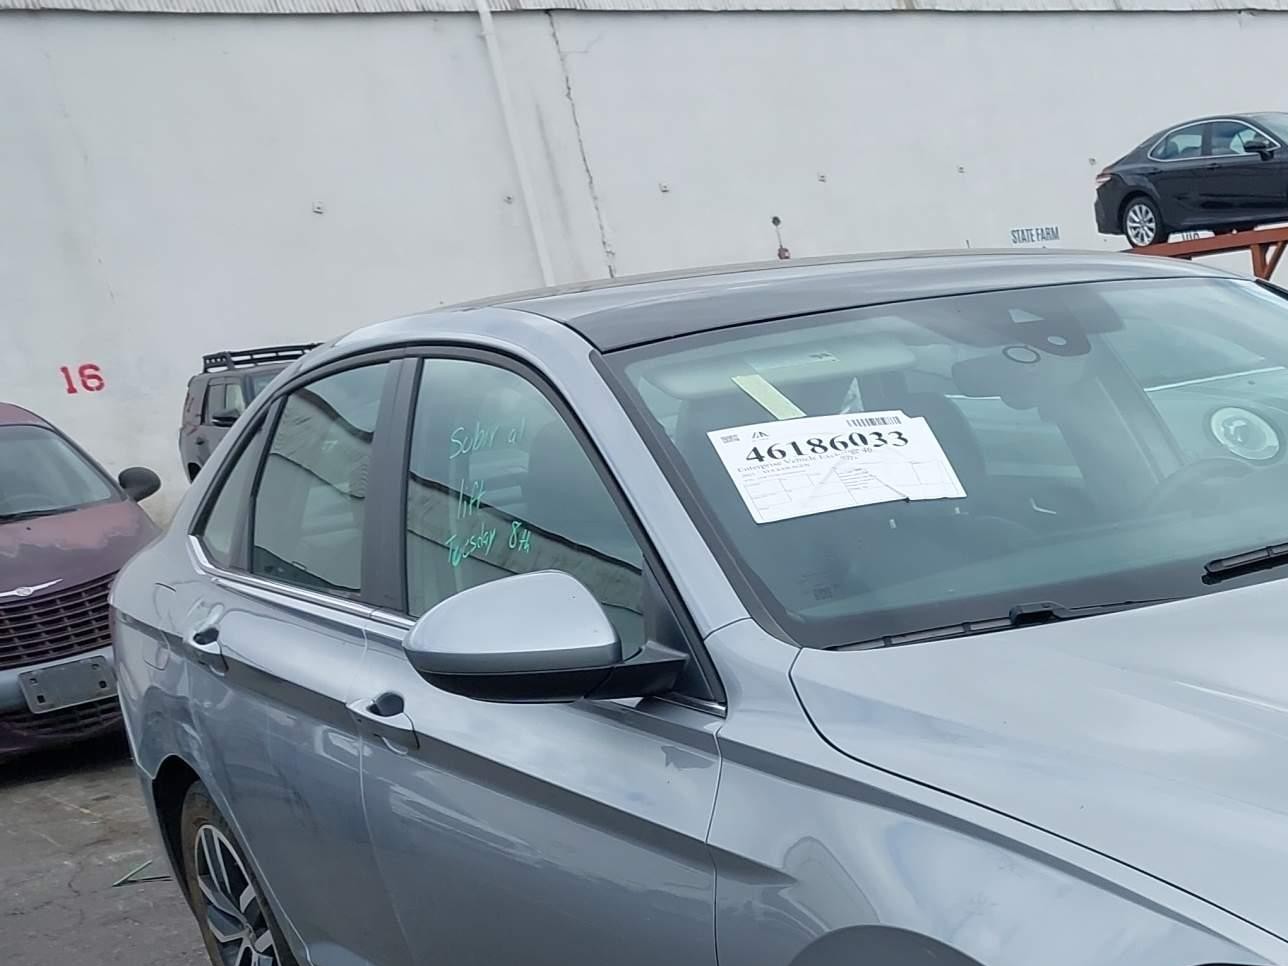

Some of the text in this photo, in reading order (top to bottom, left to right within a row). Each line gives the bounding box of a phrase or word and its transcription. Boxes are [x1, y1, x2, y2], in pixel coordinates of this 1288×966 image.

[1011, 226, 1060, 244] STATE FARM
[60, 363, 105, 394] 16
[745, 430, 909, 462] 46186033
[445, 521, 497, 567] Tuesday
